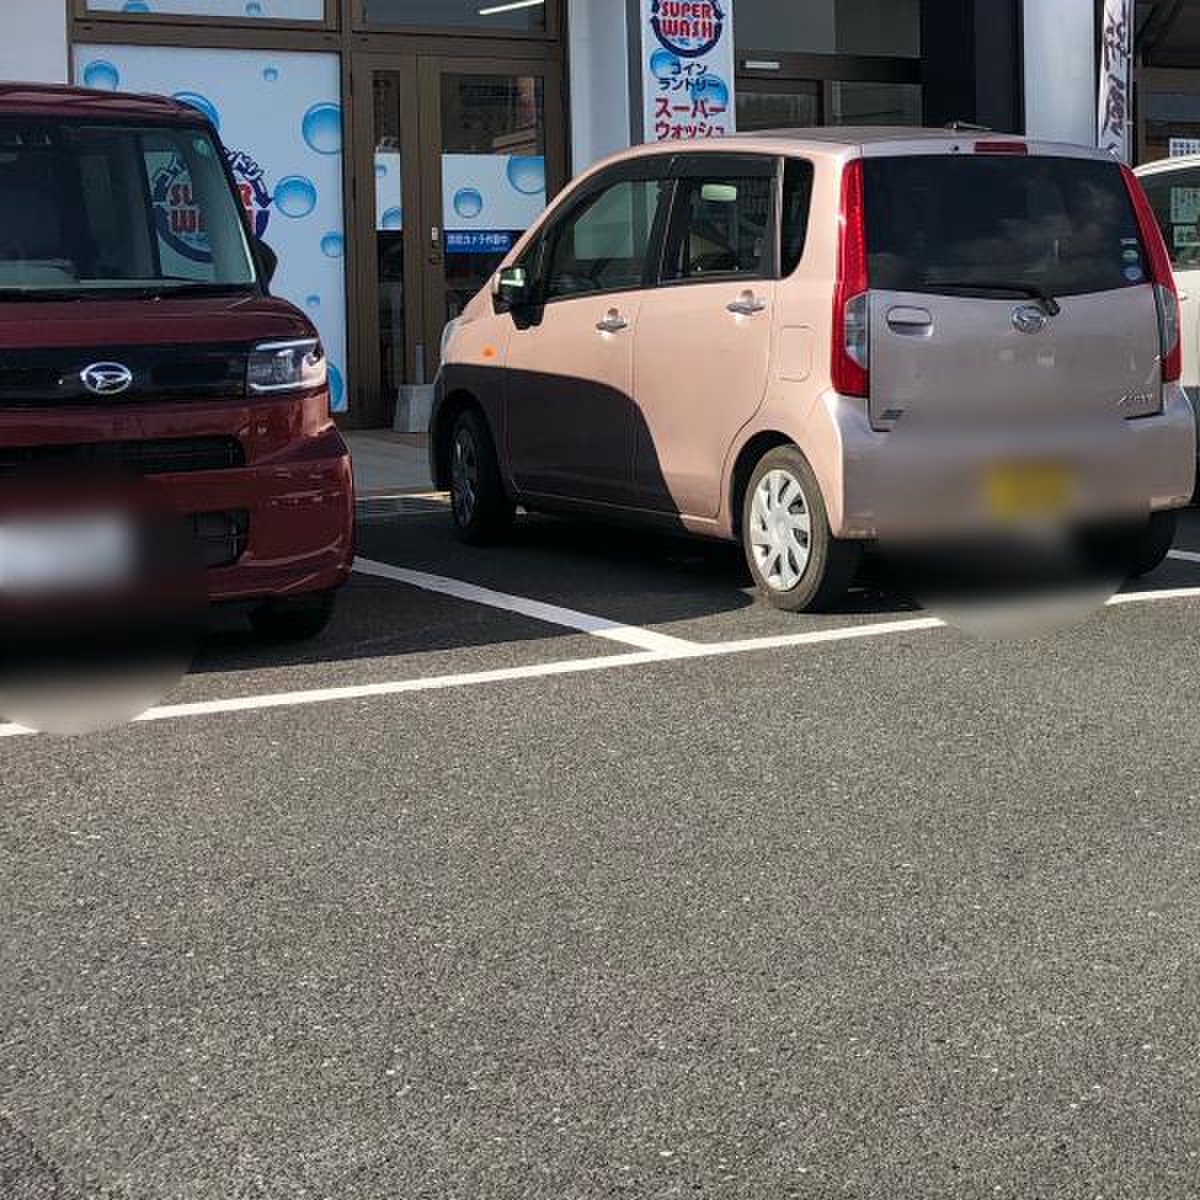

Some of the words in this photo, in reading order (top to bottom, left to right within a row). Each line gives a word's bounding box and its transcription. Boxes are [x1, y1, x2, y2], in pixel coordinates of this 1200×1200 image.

[661, 1, 712, 19] SUPER
[661, 19, 713, 39] WASH
[671, 62, 708, 76] コイン
[658, 77, 721, 93] ランドリー
[655, 98, 727, 119] スーパー
